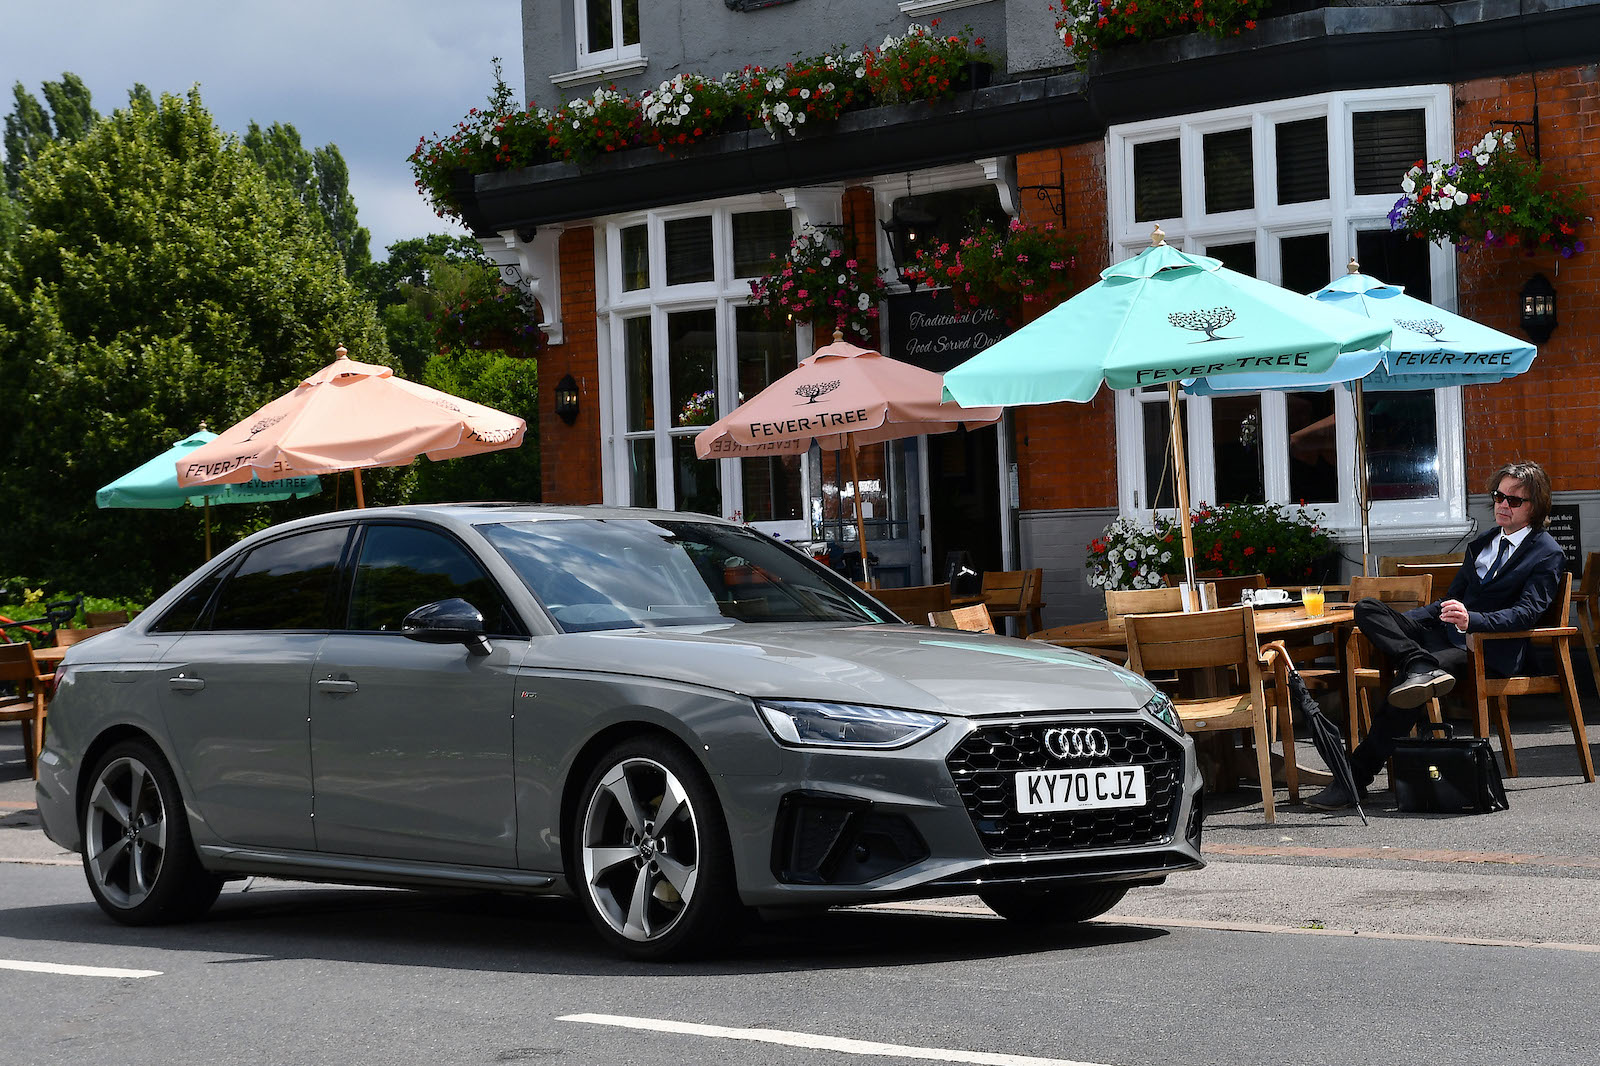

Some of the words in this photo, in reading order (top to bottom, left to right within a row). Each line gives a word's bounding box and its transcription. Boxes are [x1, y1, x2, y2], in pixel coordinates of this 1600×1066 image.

[906, 337, 932, 355] Food
[934, 335, 971, 353] Served
[973, 331, 1003, 349] Dail
[1136, 351, 1310, 384] FEVER-TREE
[1395, 351, 1513, 366] FEVER-TREE
[750, 408, 868, 438] FEVER-TREE
[1028, 773, 1089, 805] KY70
[1095, 770, 1137, 800] CJZ
